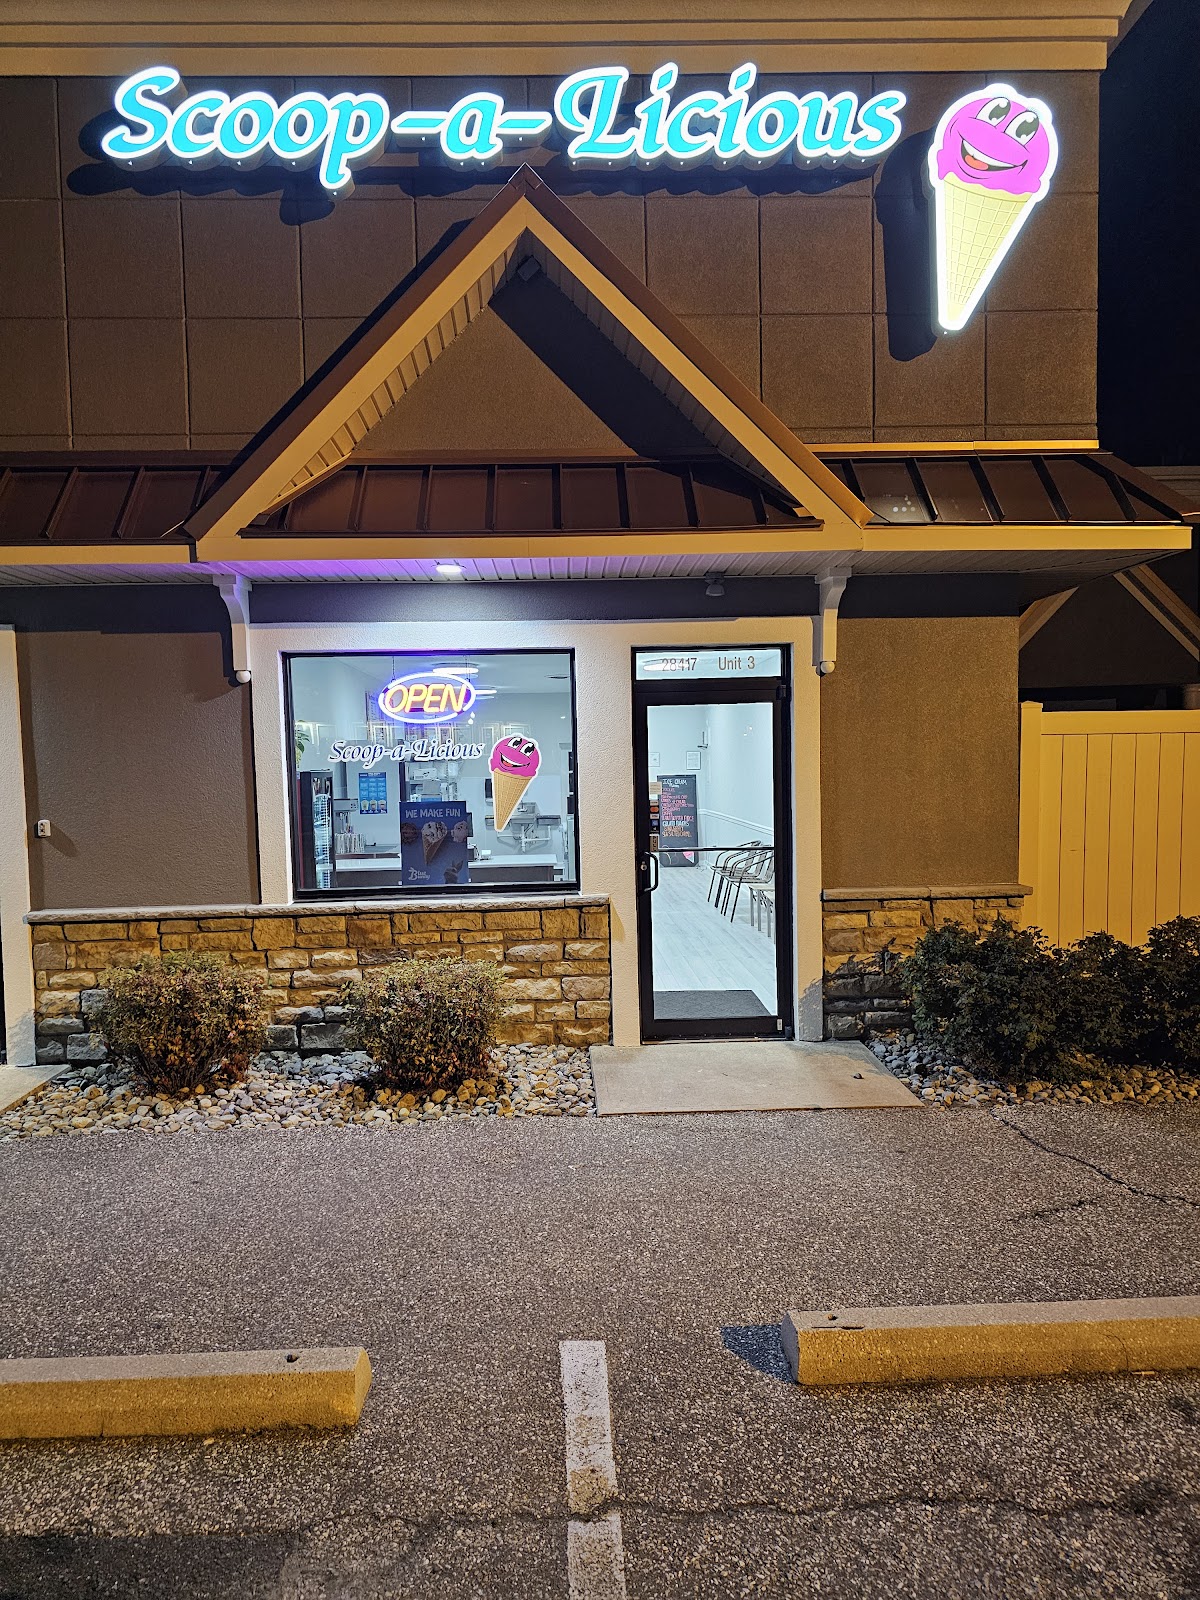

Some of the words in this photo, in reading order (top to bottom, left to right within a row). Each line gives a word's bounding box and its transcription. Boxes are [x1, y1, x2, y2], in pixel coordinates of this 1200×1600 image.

[101, 62, 907, 192] Scoop-a-Licious
[662, 657, 697, 671] 28417
[718, 656, 741, 670] Unit
[747, 656, 755, 669] 3
[383, 683, 467, 713] OPEN
[329, 738, 485, 769] Scoop-a-Licious
[405, 809, 418, 818] WE
[420, 808, 443, 818] MAKE
[445, 808, 461, 817] FUN
